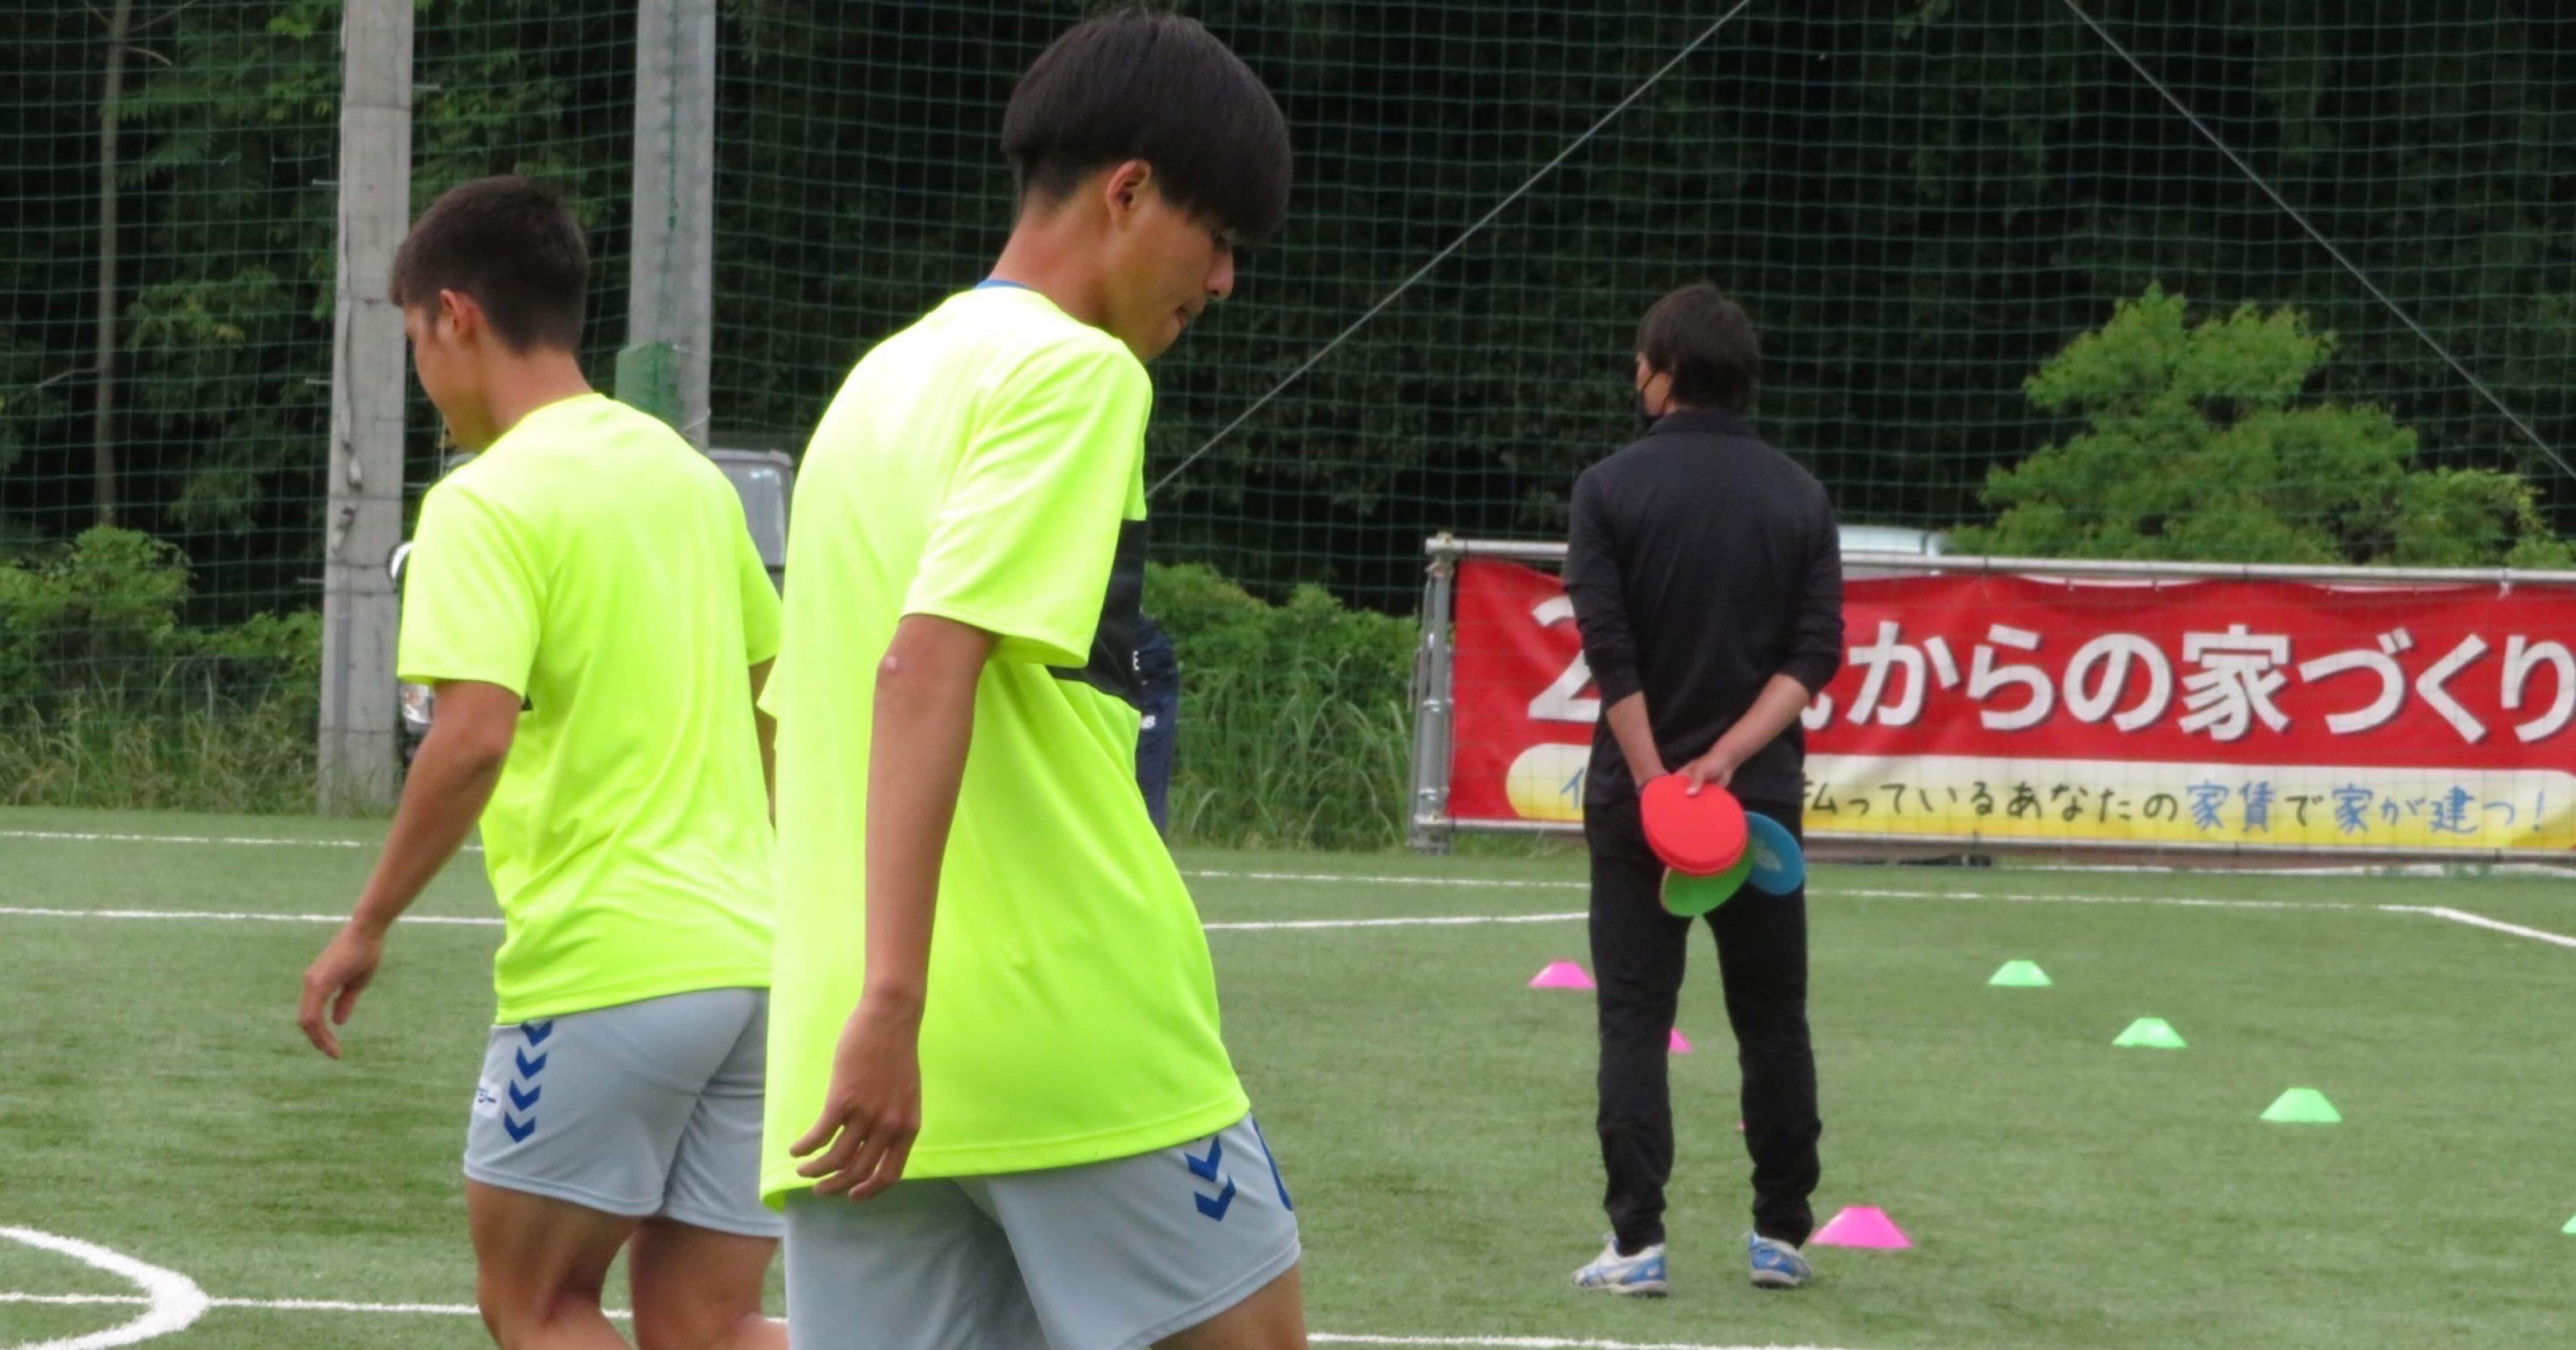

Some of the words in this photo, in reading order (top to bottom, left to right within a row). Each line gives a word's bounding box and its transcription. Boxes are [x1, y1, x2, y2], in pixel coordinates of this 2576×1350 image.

[1801, 621, 2576, 743] からの家づくり
